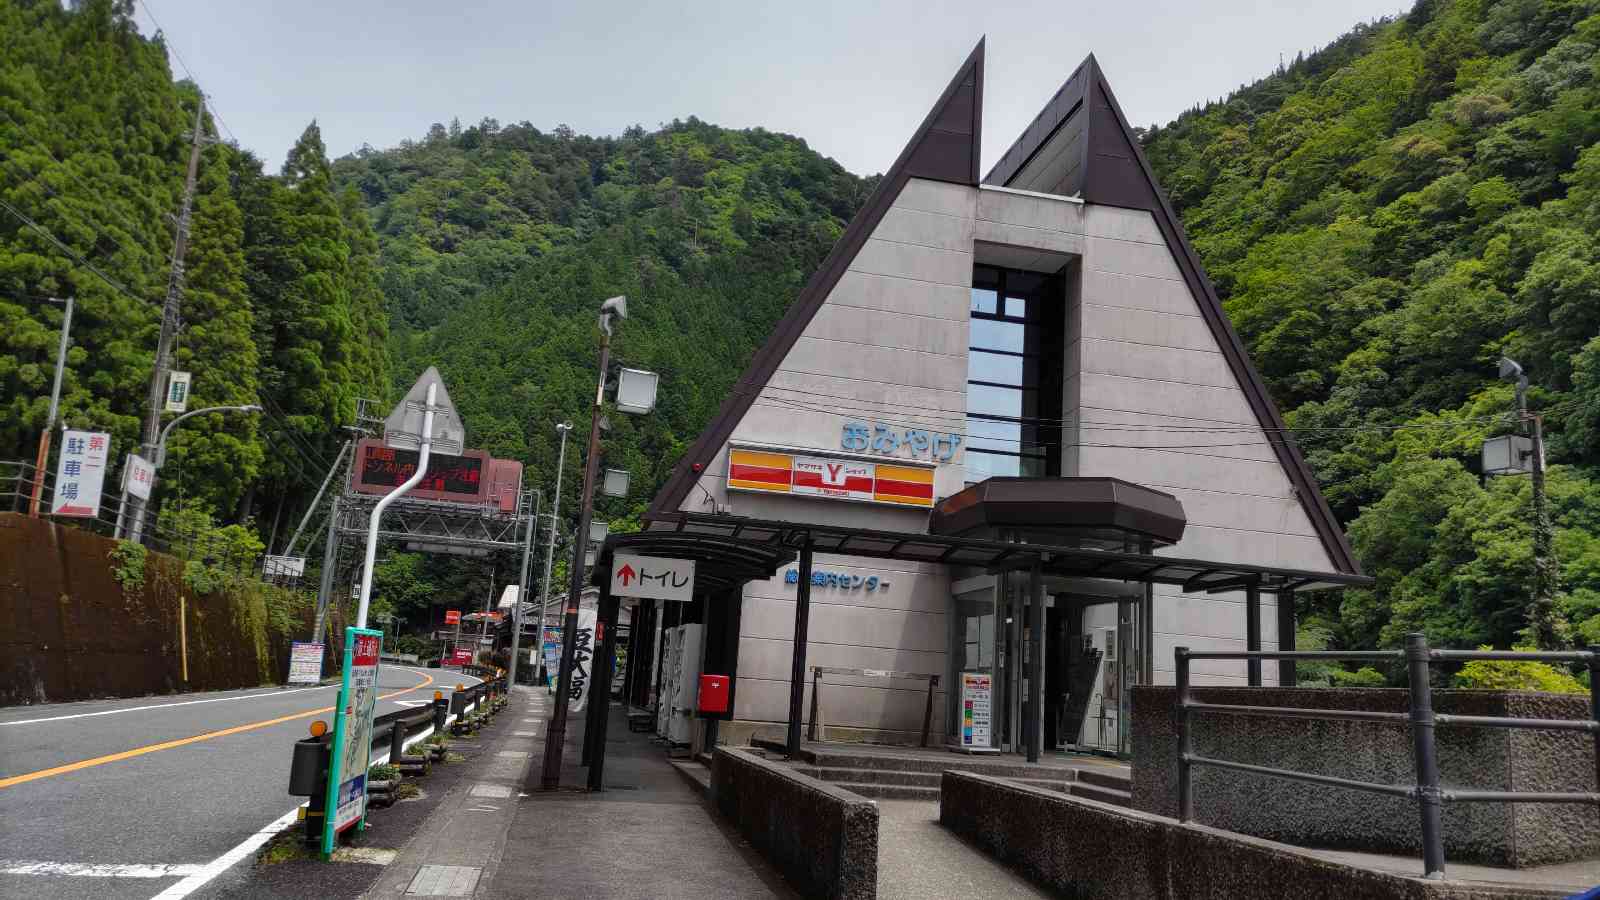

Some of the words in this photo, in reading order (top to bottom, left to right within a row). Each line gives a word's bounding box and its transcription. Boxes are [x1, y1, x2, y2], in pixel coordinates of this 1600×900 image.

[86, 436, 105, 467] 第二
[842, 422, 961, 461] おみやげ
[60, 438, 85, 500] 駐車場
[826, 463, 843, 482] Y
[640, 568, 689, 588] トイレ
[784, 568, 890, 591] 総案内センター
